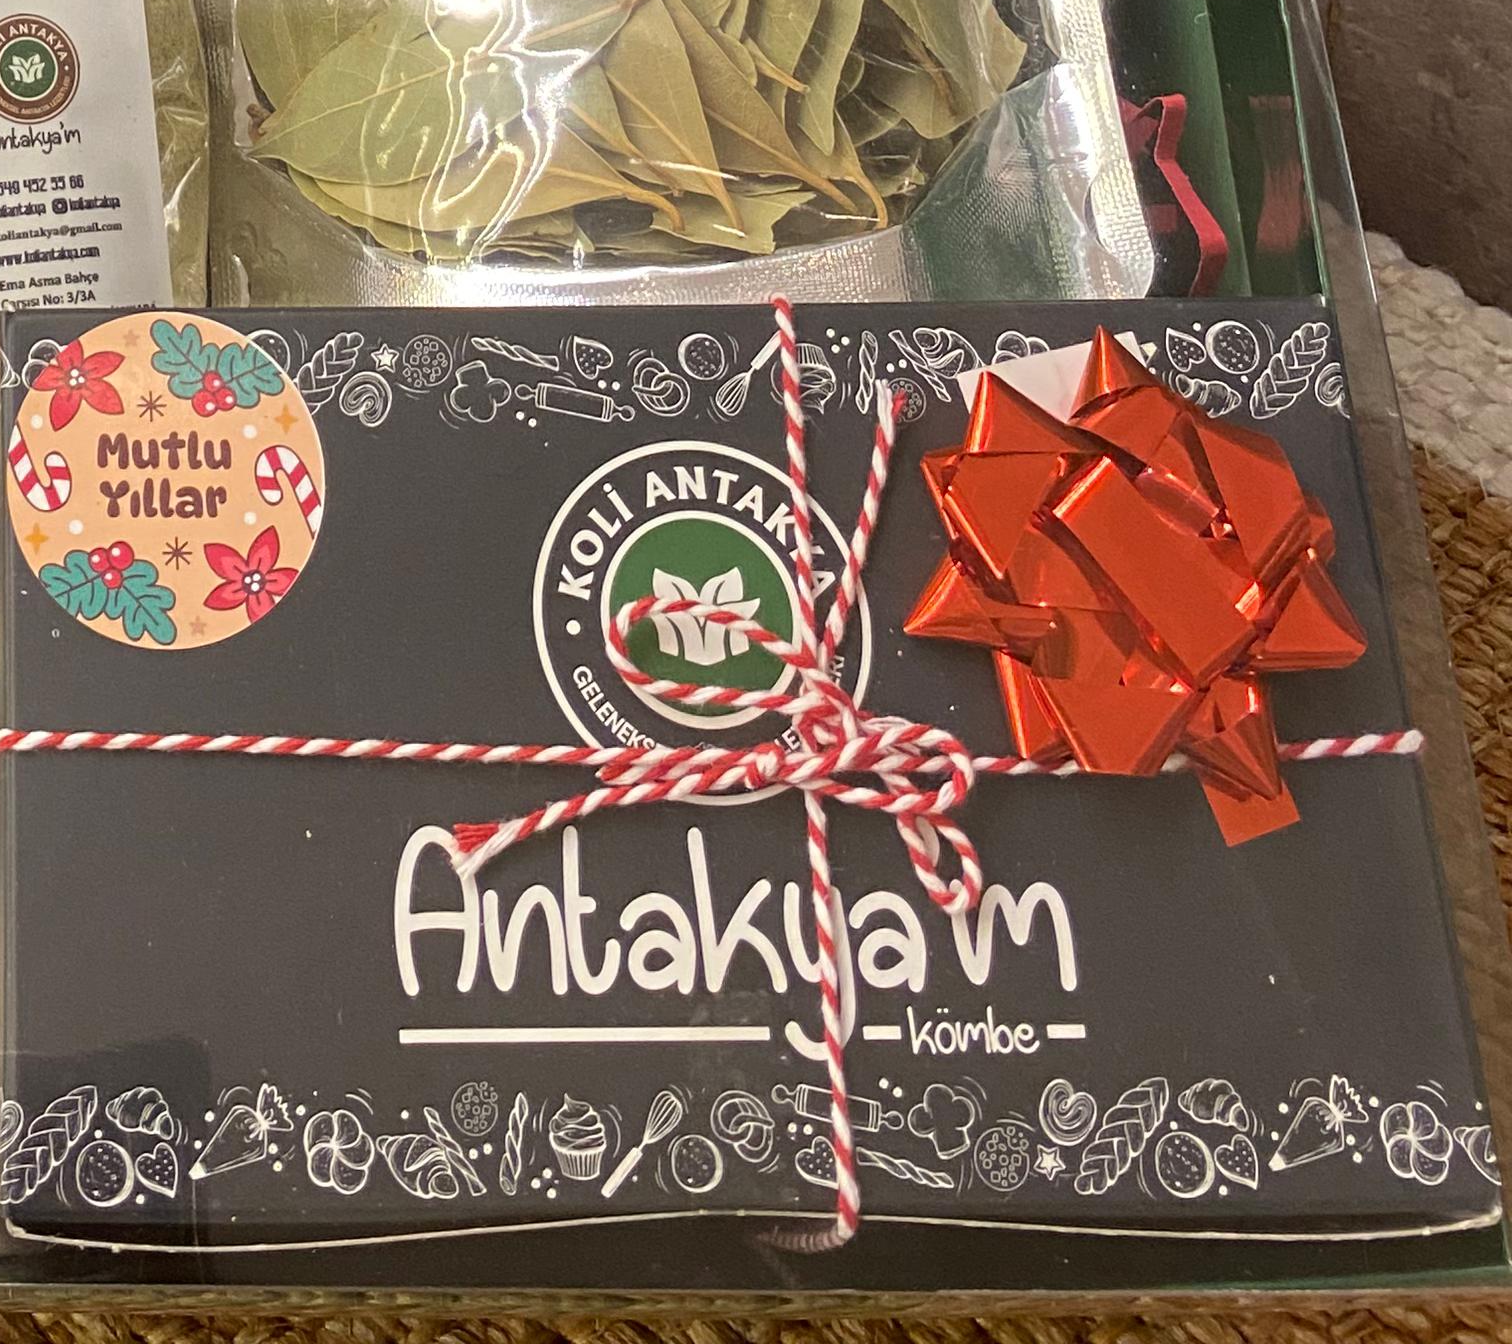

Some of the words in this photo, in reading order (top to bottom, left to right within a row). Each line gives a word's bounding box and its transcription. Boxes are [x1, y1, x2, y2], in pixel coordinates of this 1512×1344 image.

[9, 22, 68, 63] ANTAKYA
[28, 276, 62, 289] Asma
[64, 272, 100, 286] Bahçe
[43, 294, 64, 307] No:
[66, 289, 96, 305] 3/3A
[96, 430, 233, 472] Mutlu
[99, 477, 228, 520] Yıllar
[557, 482, 634, 601] KOLİ
[573, 665, 658, 750] GELENEKS
[910, 1006, 1039, 1056] kömbe
